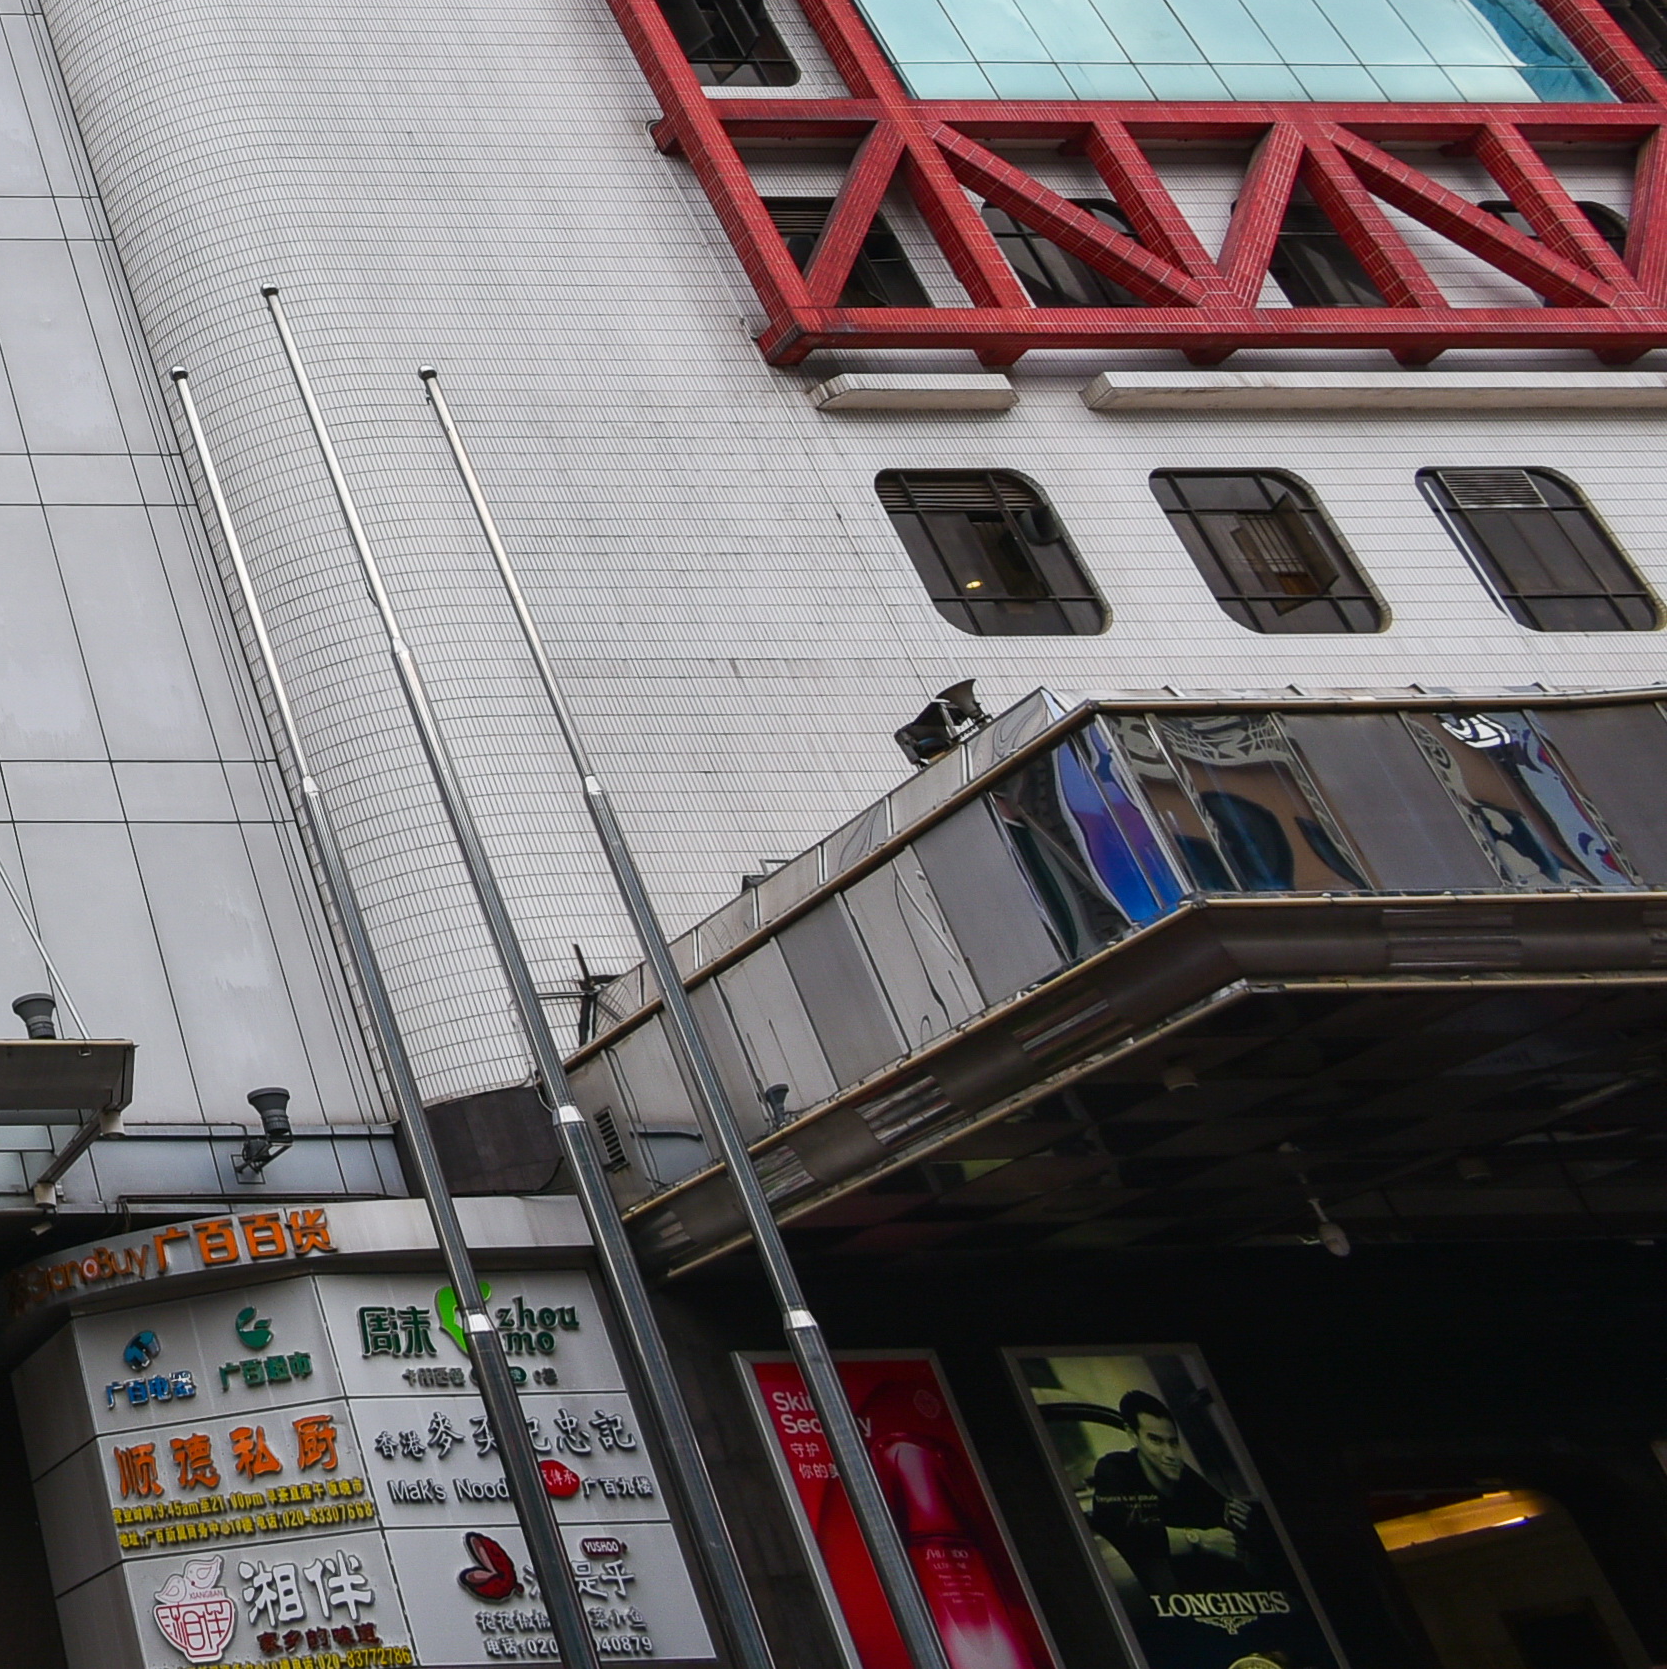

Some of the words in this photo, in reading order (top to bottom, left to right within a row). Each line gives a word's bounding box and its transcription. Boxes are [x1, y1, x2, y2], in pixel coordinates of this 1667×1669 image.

[153, 1207, 338, 1273] 广百百货
[358, 1305, 438, 1358] 周末
[496, 1295, 580, 1330] zhou
[104, 1369, 197, 1410] 广百电器
[218, 1351, 314, 1393] 广百超市
[113, 1414, 340, 1498] 顺德私厨
[789, 1441, 820, 1458] 守护
[388, 1478, 448, 1504] Mak's
[455, 1477, 510, 1502] Nood
[581, 1476, 655, 1497] 广百九楼
[584, 1540, 619, 1554] YUSHOO
[237, 1549, 376, 1628] 湘伴
[1149, 1590, 1292, 1618] LONGINES
